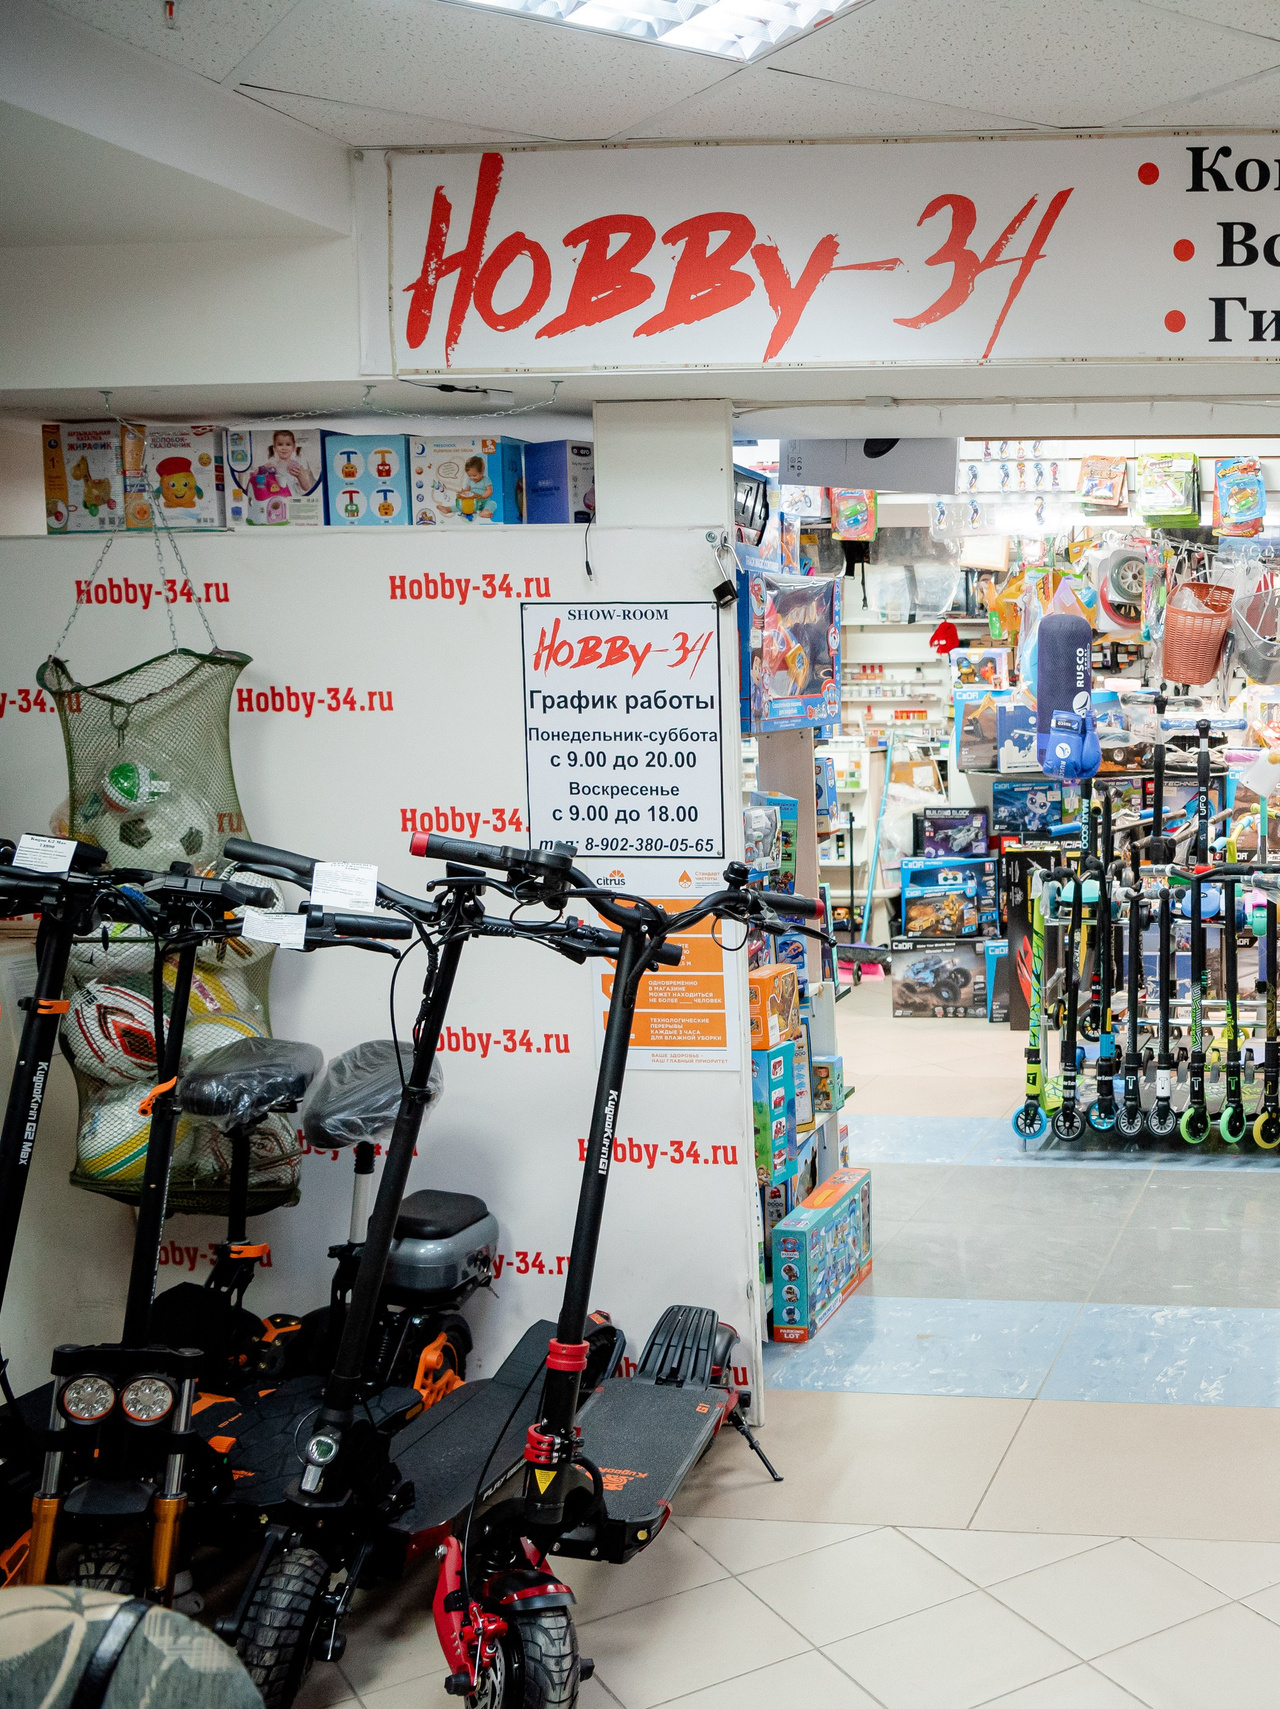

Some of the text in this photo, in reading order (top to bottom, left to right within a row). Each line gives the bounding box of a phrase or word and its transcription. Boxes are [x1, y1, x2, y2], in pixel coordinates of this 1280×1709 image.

[75, 577, 229, 609] Hobby-34.ru
[389, 571, 551, 605] Hobby-34.ru
[567, 609, 669, 621] SHOW-ROOM
[1076, 647, 1085, 688] RUSCO
[237, 686, 393, 718] Hobby-34.ru
[529, 690, 715, 714] График работы
[528, 727, 718, 745] Понедельник-суббота
[567, 751, 607, 767] 9.00
[613, 755, 639, 770] до
[645, 751, 697, 768] 20.00
[569, 782, 680, 798] Воскресенье
[400, 807, 529, 838] Hobby-34.
[569, 805, 608, 821] 9.00
[614, 809, 640, 824] до
[647, 805, 699, 822] 18.00
[585, 838, 714, 852] 8-902-380-05-65
[1026, 841, 1082, 849] TECHNICIA
[597, 876, 626, 886] citrus
[414, 1026, 570, 1059] obby-34.ru
[577, 1138, 738, 1169] Hbby-34.ru
